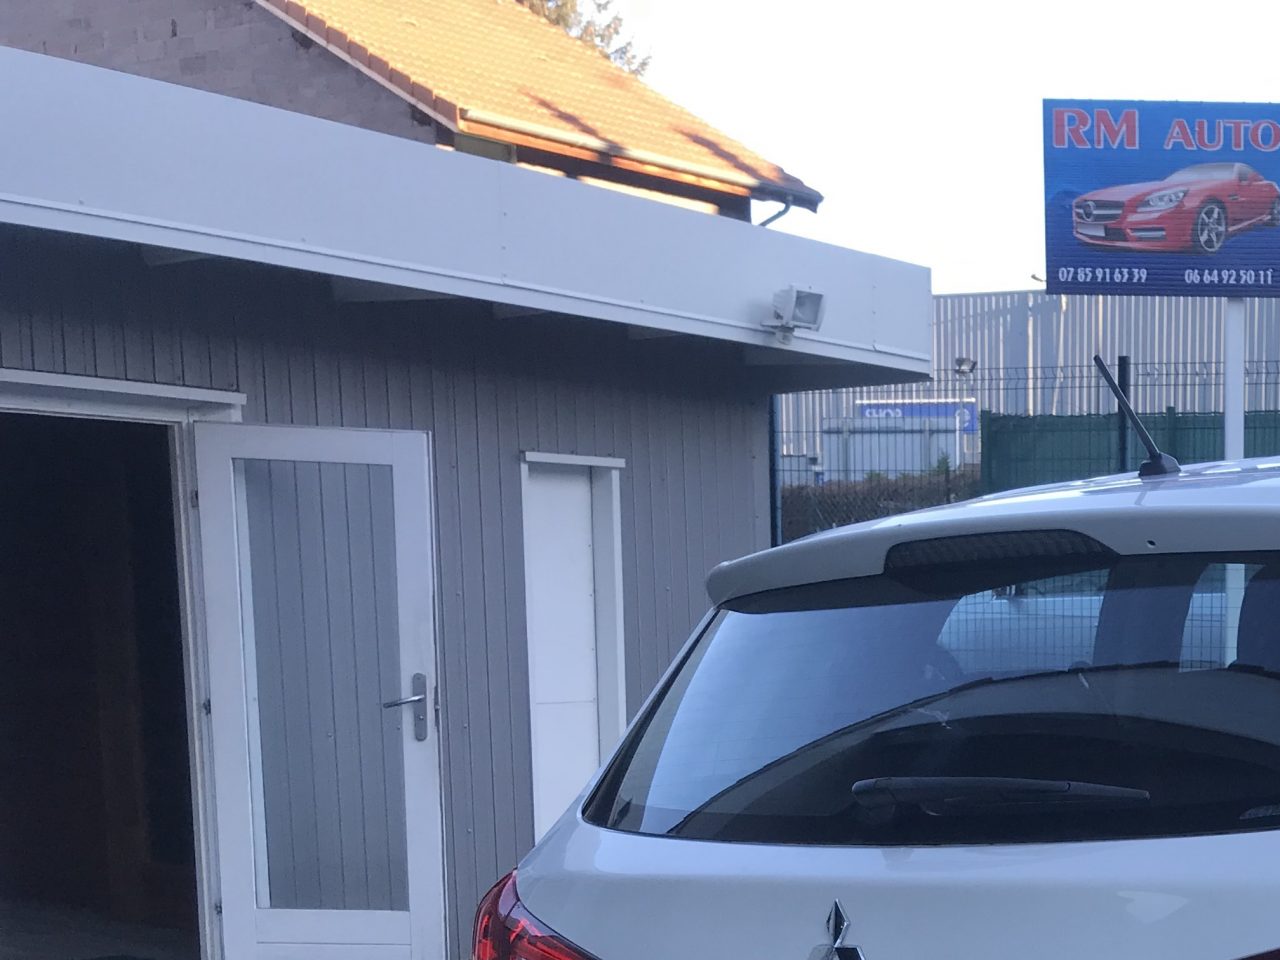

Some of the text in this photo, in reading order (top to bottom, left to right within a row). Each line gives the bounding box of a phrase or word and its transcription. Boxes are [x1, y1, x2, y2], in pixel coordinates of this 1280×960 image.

[1052, 108, 1139, 149] RM
[1058, 267, 1074, 282] 07
[1095, 267, 1110, 282] 91
[1132, 268, 1147, 283] 39
[1184, 269, 1200, 284] 06
[1203, 269, 1219, 284] 64
[1221, 269, 1237, 284] 92
[1240, 269, 1255, 284] 50
